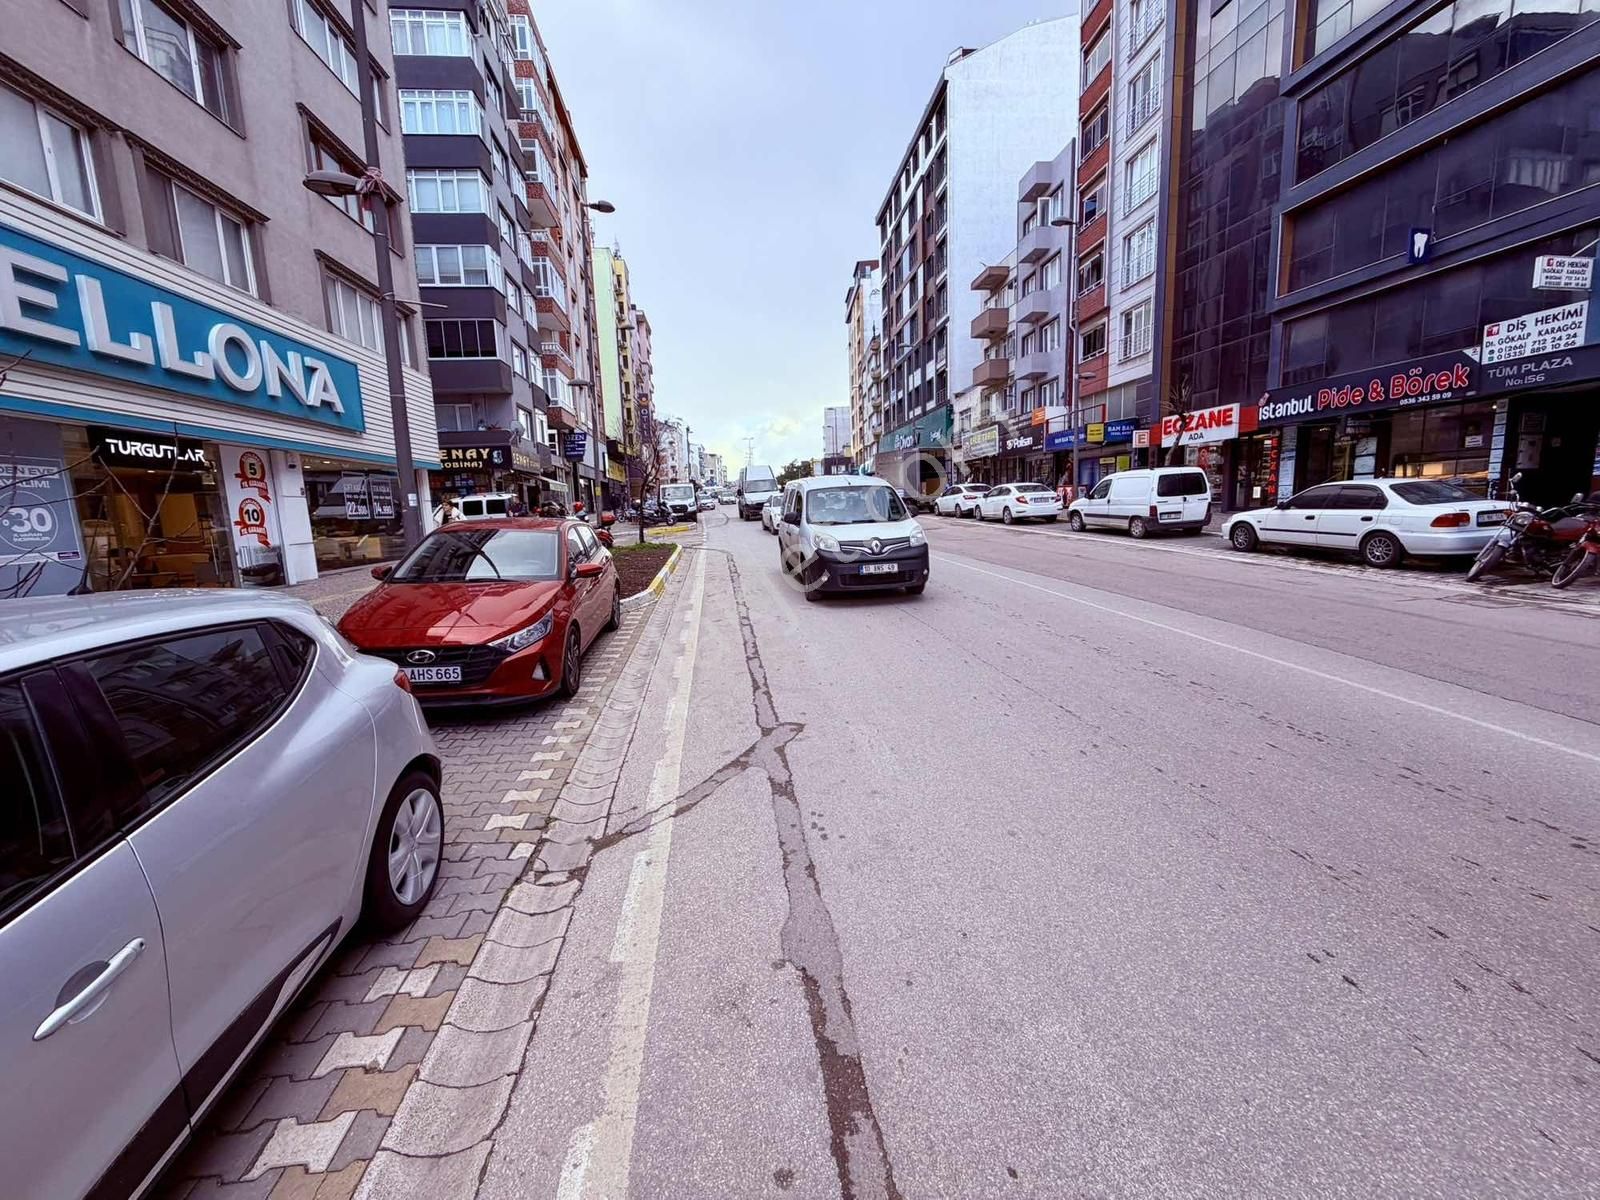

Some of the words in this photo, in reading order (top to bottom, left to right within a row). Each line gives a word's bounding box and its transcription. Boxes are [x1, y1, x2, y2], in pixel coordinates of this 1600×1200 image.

[1507, 319, 1527, 333] DİŞ
[1535, 305, 1585, 327] HEKİMİ
[1497, 331, 1531, 346] GÖKALP
[1537, 320, 1584, 337] KARAGÖZ
[1550, 335, 1563, 343] 24
[1565, 332, 1578, 341] 24
[1487, 365, 1518, 379] TÜM
[1520, 356, 1574, 375] PLAZA
[1317, 386, 1364, 411] Pide
[1368, 378, 1385, 402] &
[1389, 362, 1470, 399] Börek
[1162, 406, 1233, 436] ECZANE
[1188, 432, 1205, 440] ADA
[105, 438, 205, 462] TURGUTLAR
[248, 462, 258, 476] 5
[245, 508, 260, 522] 10
[410, 668, 434, 681] AHS
[435, 667, 460, 680] 665
